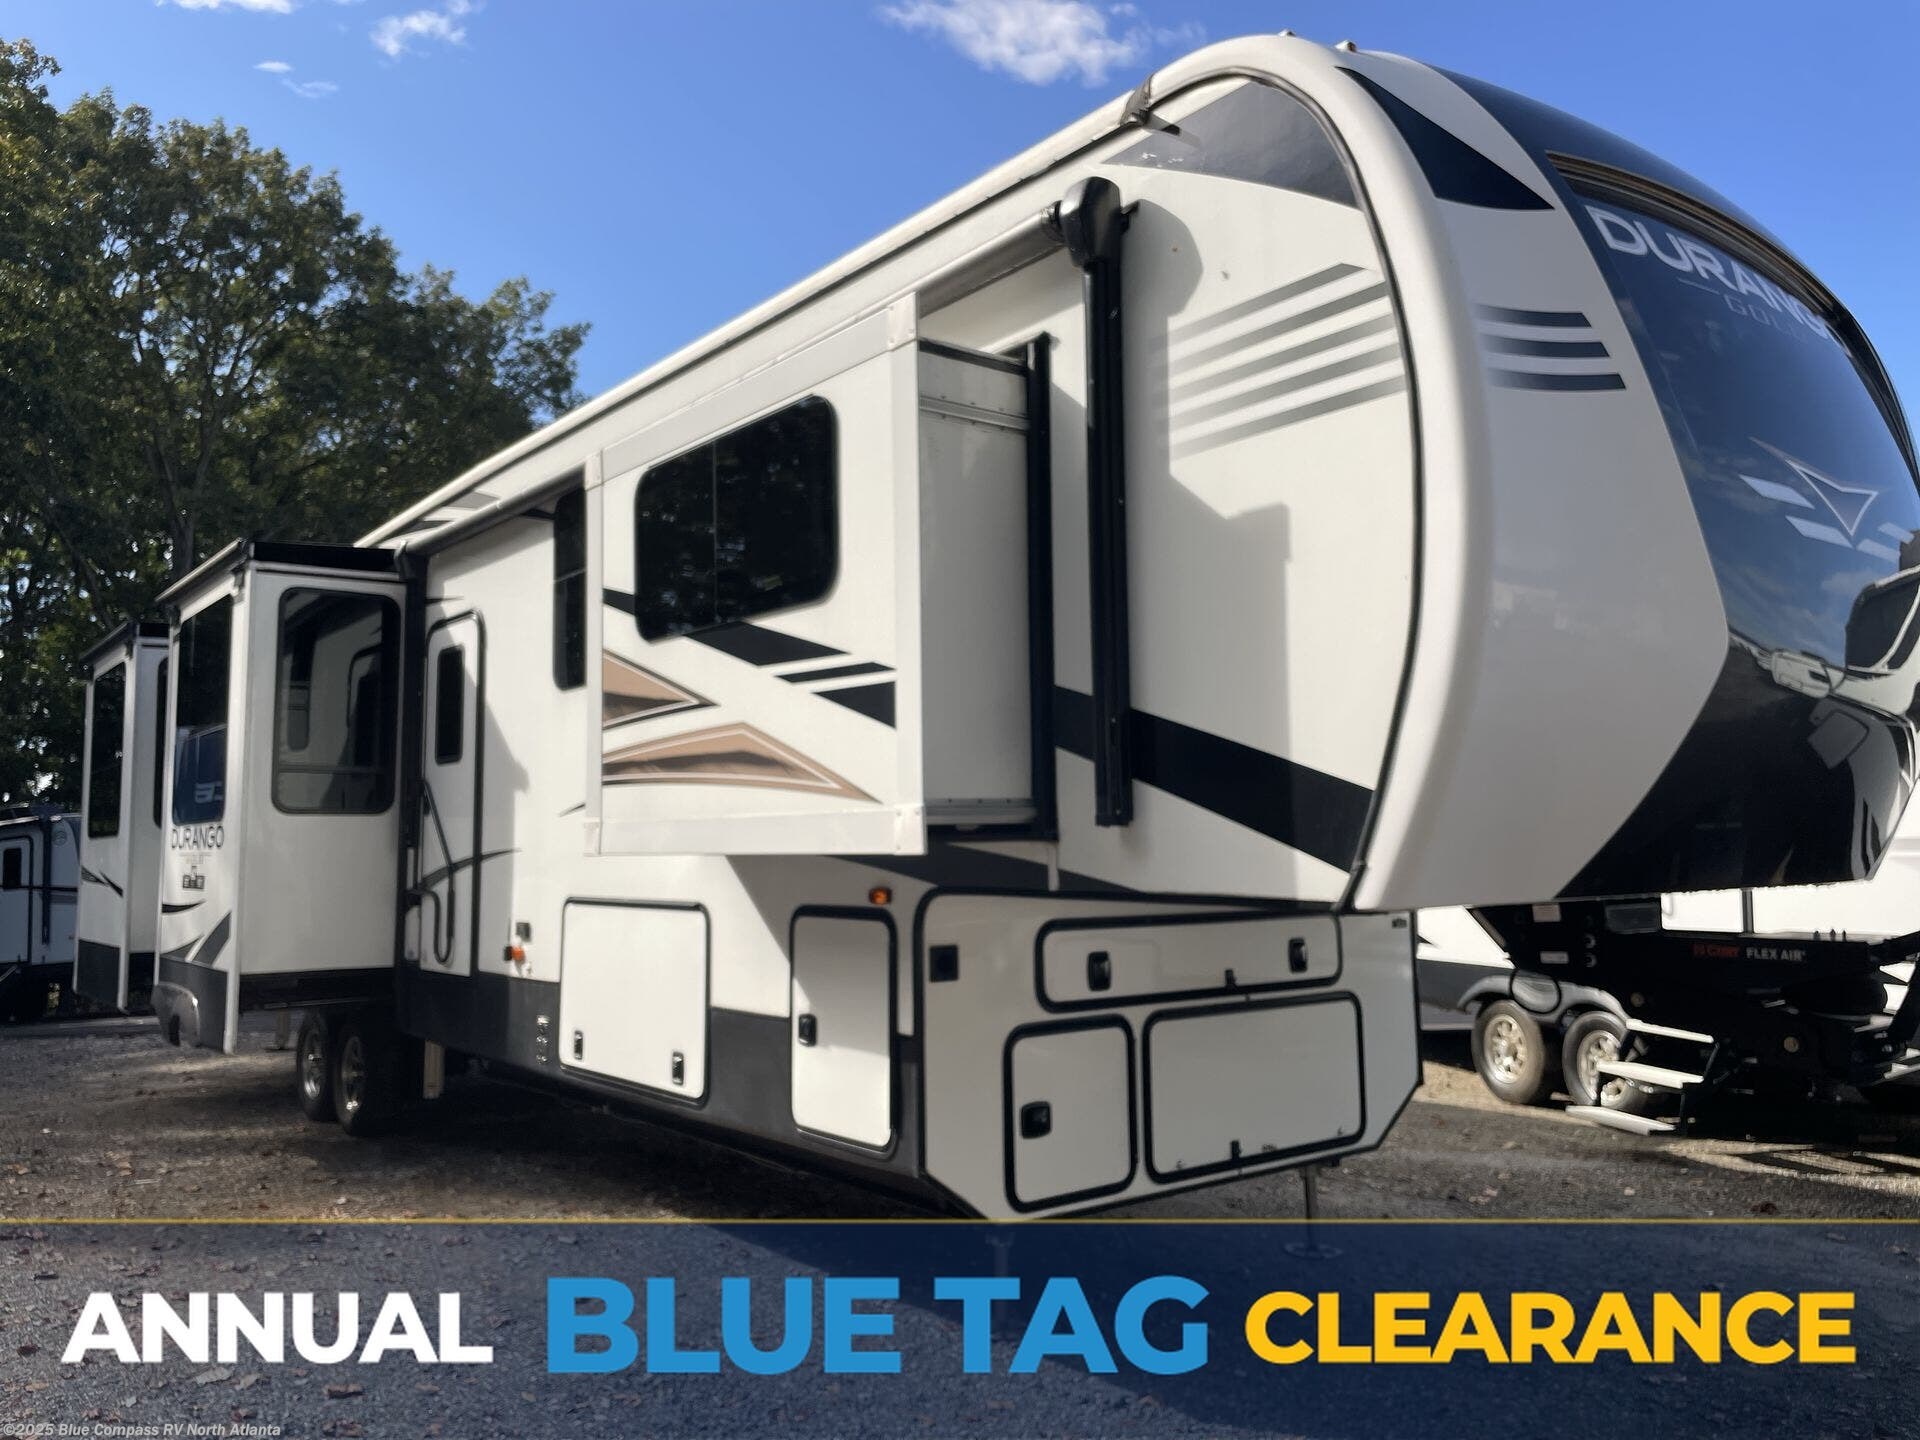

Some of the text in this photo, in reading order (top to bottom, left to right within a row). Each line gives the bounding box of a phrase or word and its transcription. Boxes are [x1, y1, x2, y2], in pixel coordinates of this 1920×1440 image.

[1585, 204, 1836, 342] DURANG
[171, 825, 225, 850] DURANGO
[1745, 945, 1777, 959] FLEX
